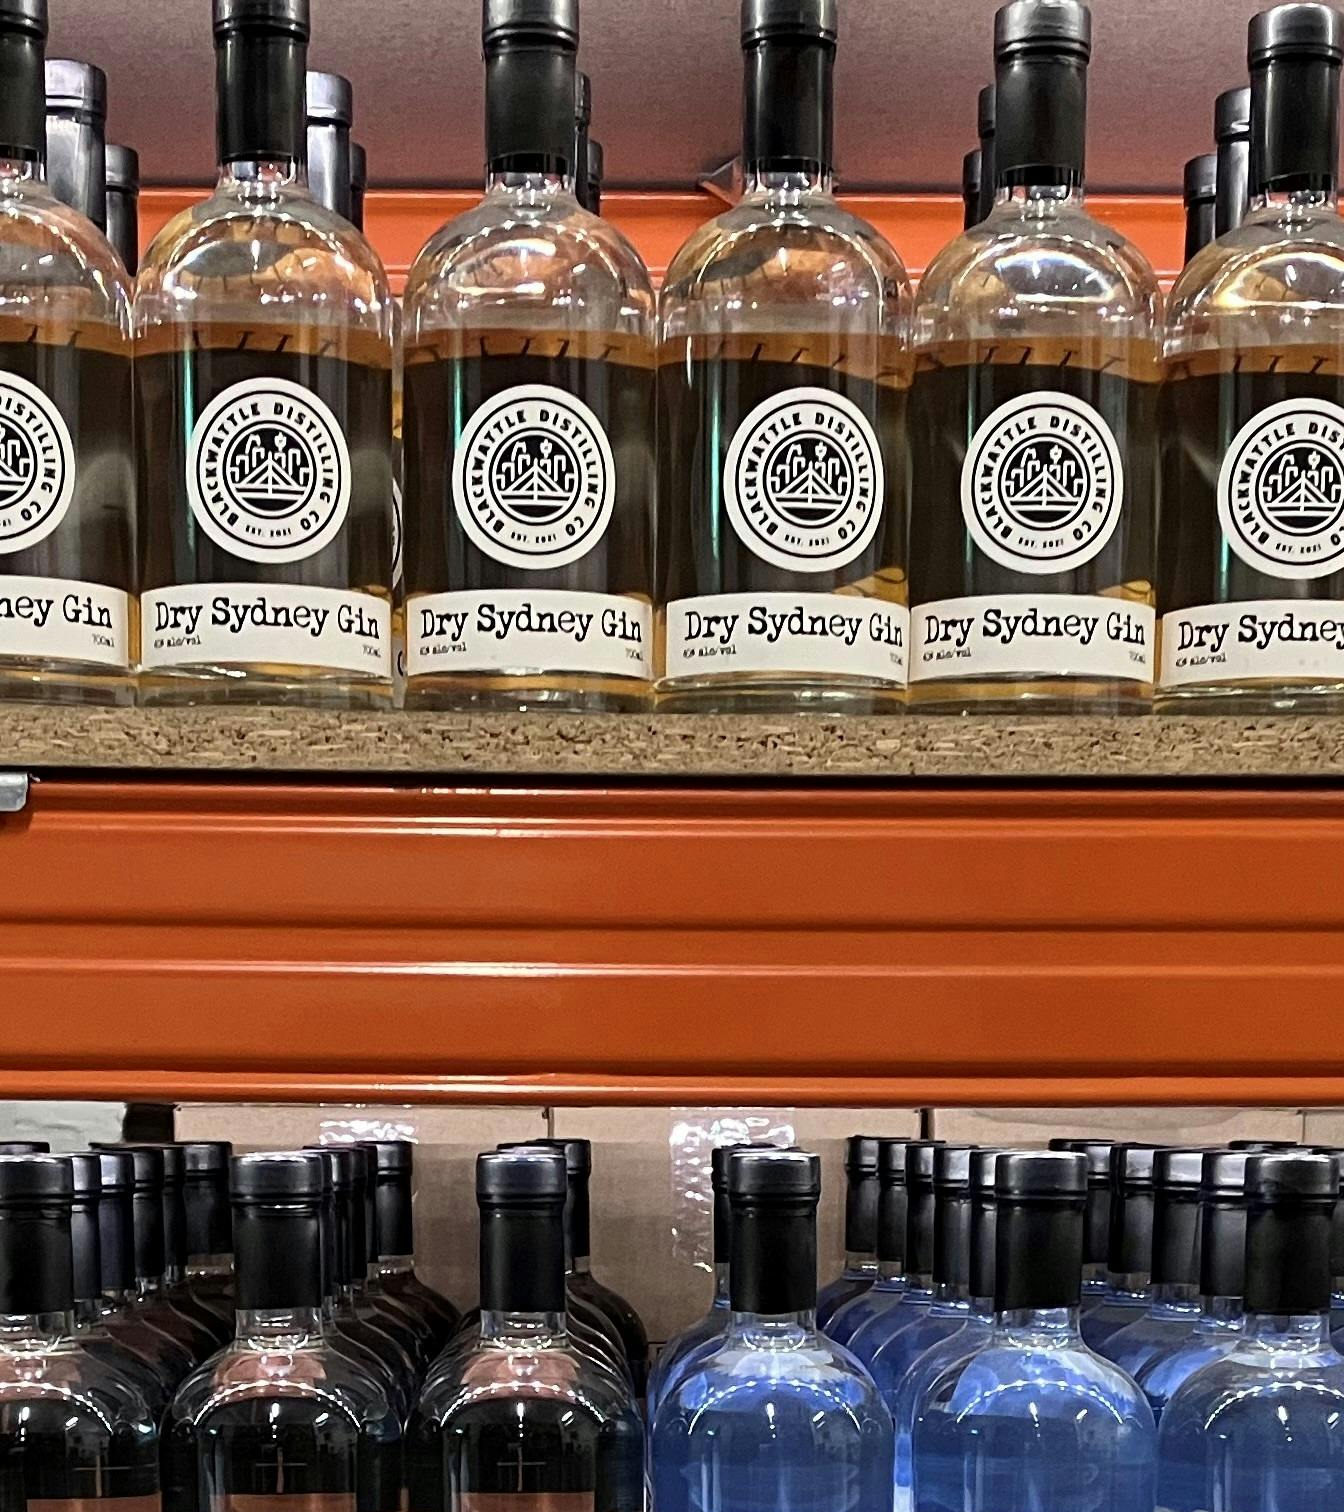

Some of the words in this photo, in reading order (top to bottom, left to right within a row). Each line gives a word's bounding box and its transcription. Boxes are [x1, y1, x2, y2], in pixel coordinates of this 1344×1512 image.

[206, 402, 260, 526] BLACKWATTLE
[274, 402, 334, 504] DISTILLING
[300, 510, 320, 530] CO
[63, 594, 112, 628] Gin
[155, 602, 203, 634] Dry
[212, 597, 329, 637] Sydney
[338, 605, 379, 639] Gin
[421, 609, 469, 641] Dry
[477, 603, 593, 642] Sydney
[602, 609, 642, 643] Gin
[685, 611, 739, 644] Dry
[748, 606, 862, 646] Sydney
[924, 615, 975, 647] Dry
[983, 608, 1099, 645] Sydney
[1178, 621, 1229, 653] Dry
